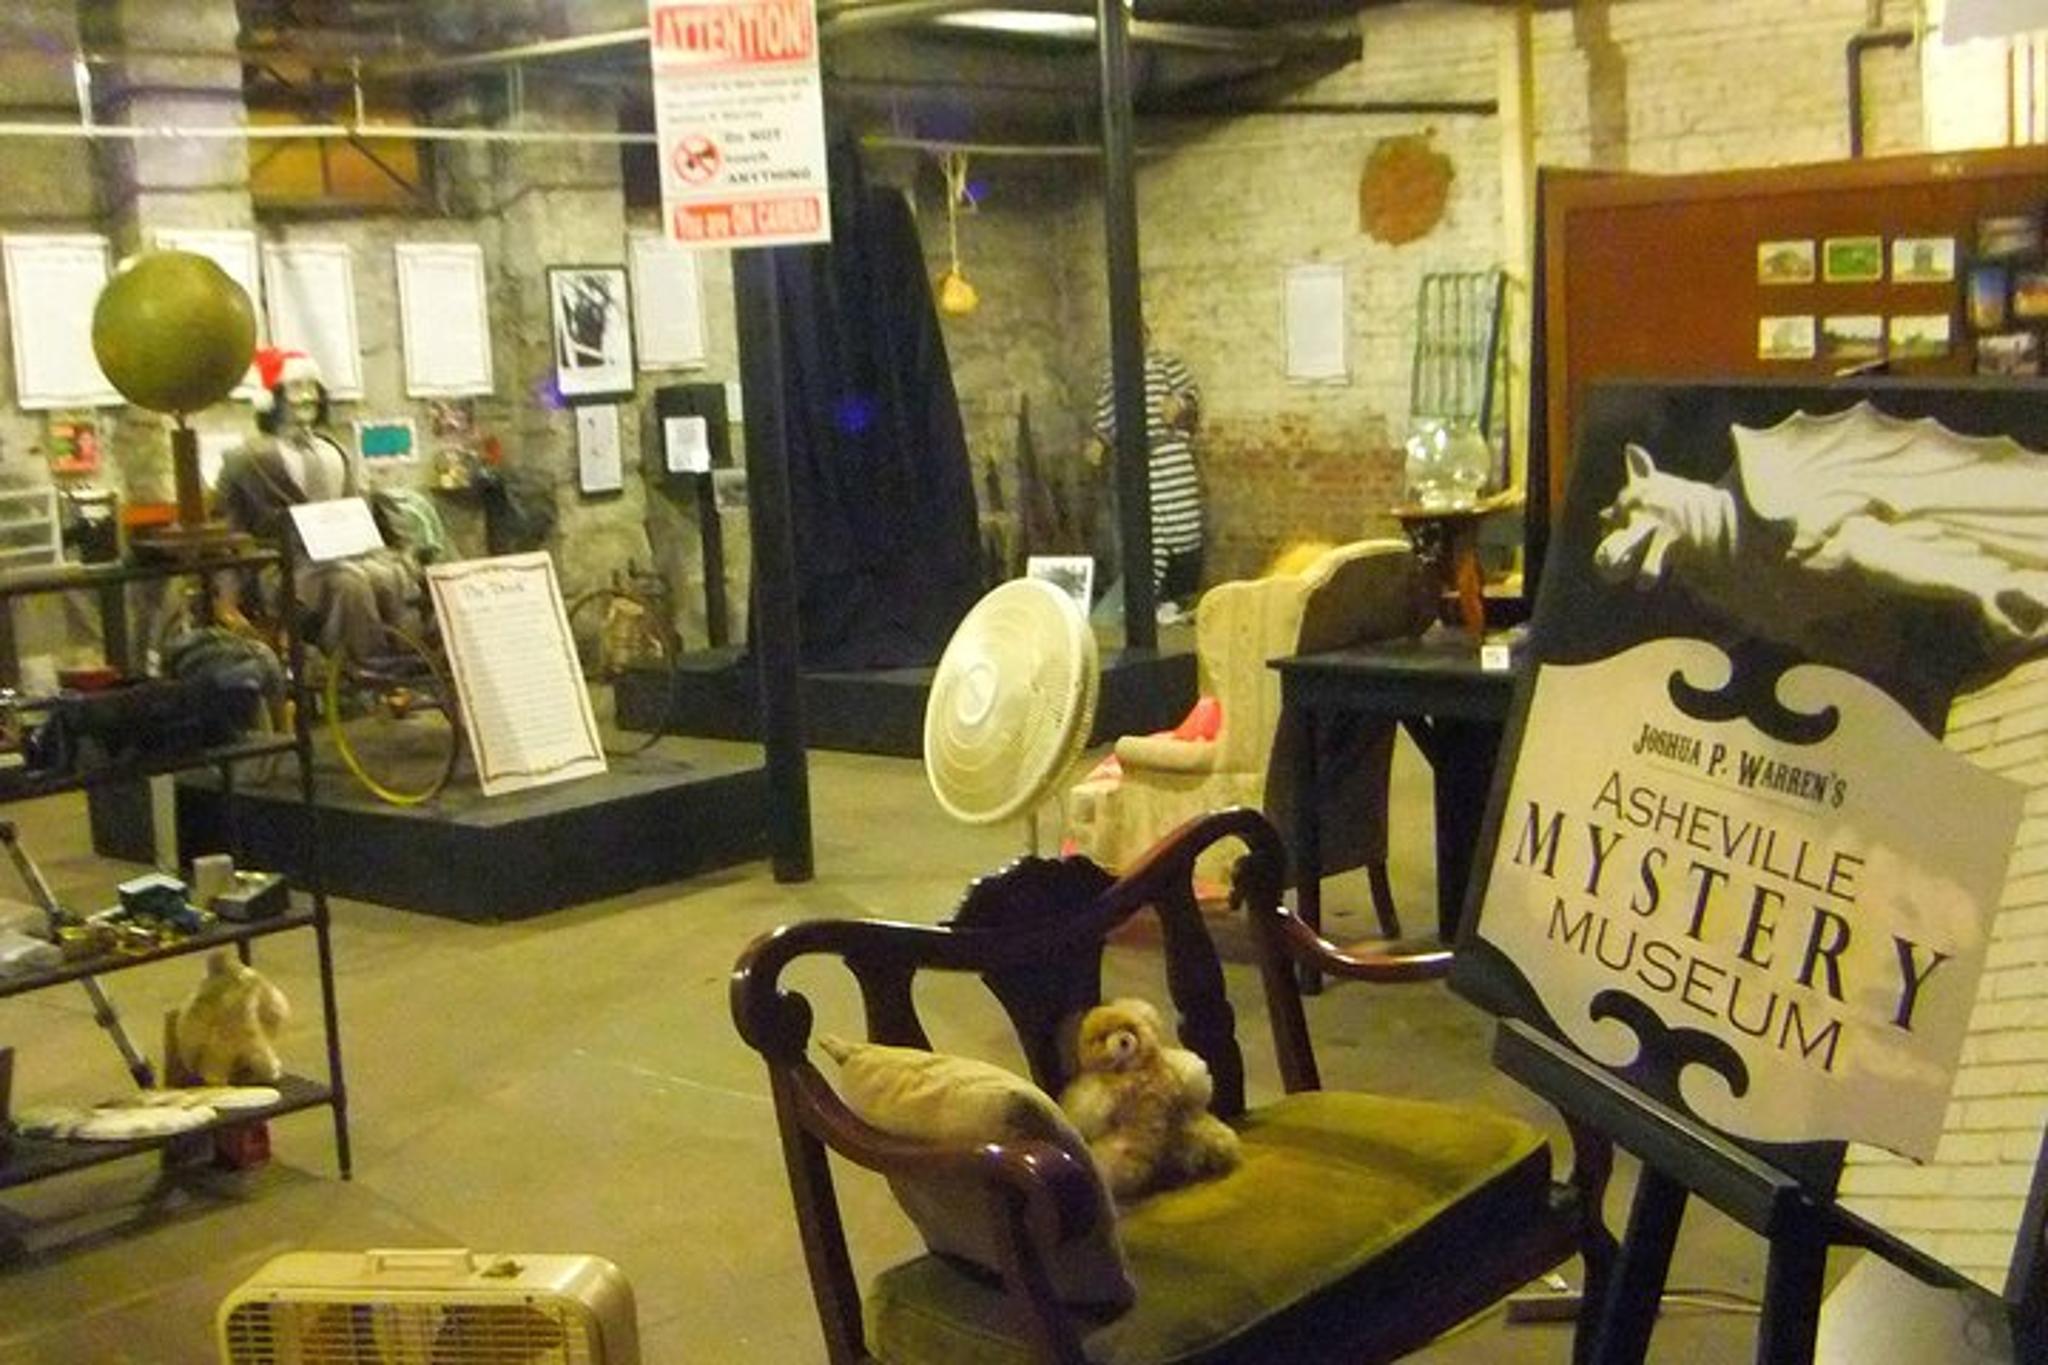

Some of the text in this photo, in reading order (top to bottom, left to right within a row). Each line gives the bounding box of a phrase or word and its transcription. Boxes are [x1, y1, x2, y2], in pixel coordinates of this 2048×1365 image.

[659, 2, 812, 59] ATTENTION!
[749, 128, 781, 141] NOT
[727, 168, 813, 184] ANYTHING
[733, 203, 754, 235] ON
[757, 200, 817, 233] CAMERA
[1633, 723, 1848, 809] JOSHUA P. WARREN'S
[1591, 771, 1865, 901] ASHEVILLE
[1513, 801, 1954, 1032] MYSTERY
[1547, 898, 1844, 1073] MUSEUM
